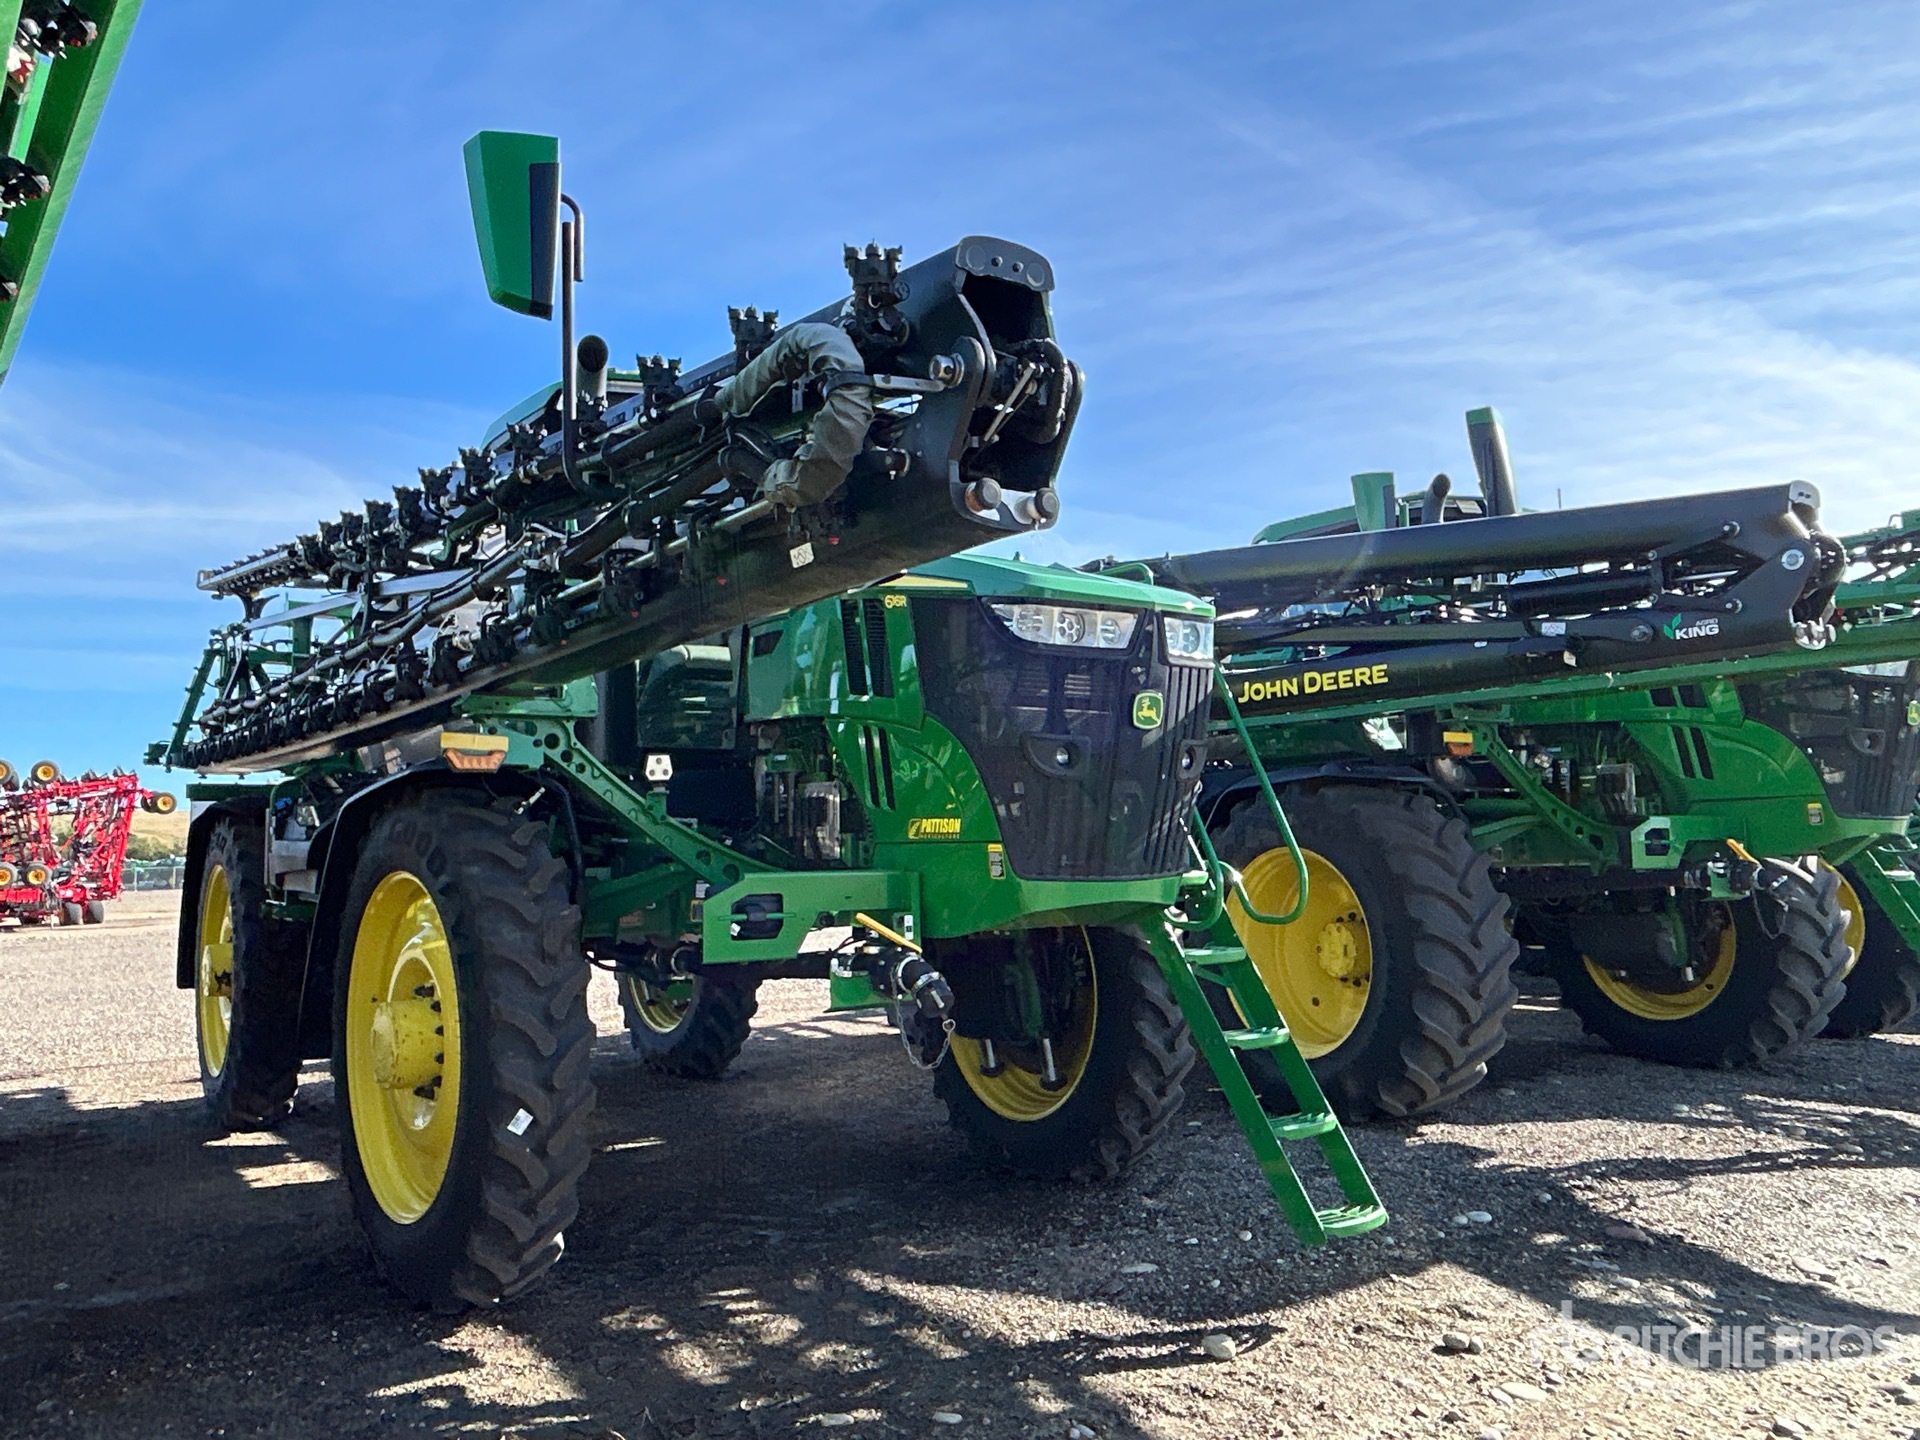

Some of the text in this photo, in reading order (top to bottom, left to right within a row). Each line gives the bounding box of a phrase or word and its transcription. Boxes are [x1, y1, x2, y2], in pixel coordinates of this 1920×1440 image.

[1695, 617, 1719, 627] AGRO
[1674, 623, 1720, 640] KING
[1237, 663, 1389, 704] JOHN DEERE
[920, 818, 962, 833] PATTISON
